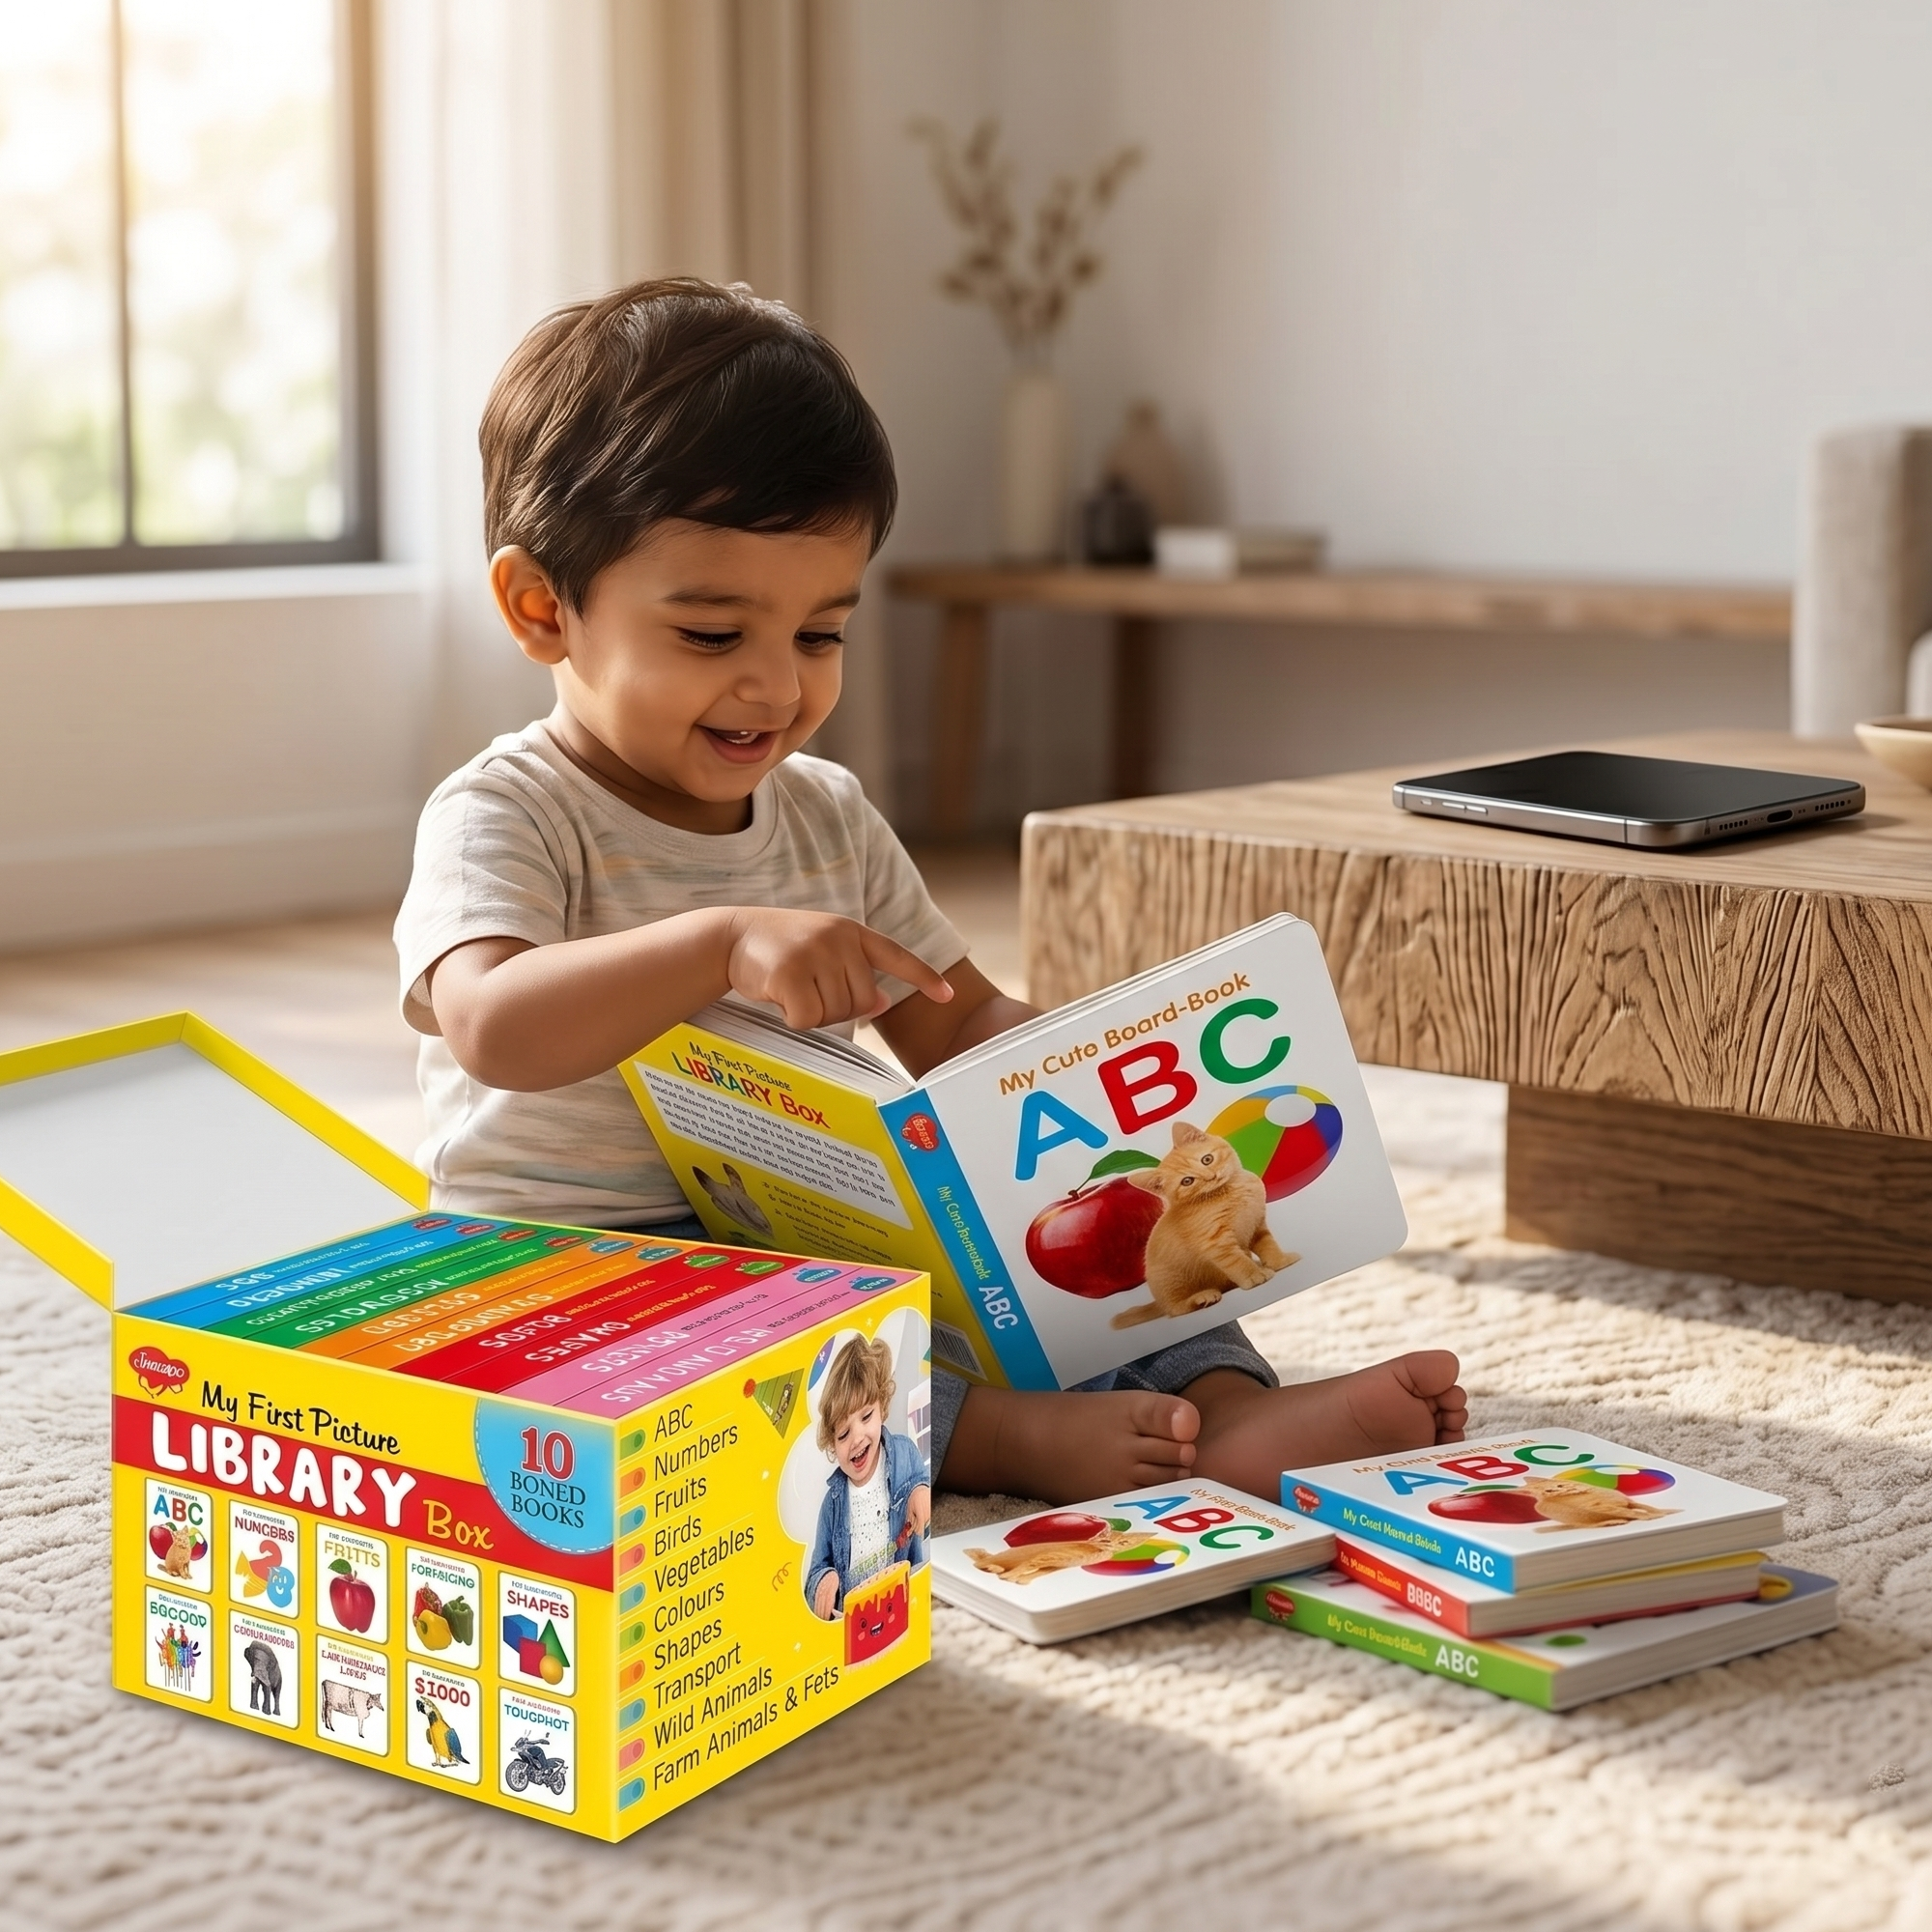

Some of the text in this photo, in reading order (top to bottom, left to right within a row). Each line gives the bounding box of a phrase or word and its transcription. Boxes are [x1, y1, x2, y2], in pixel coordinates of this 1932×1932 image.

[689, 1041, 711, 1065] My
[999, 1070, 1036, 1095] My
[1103, 971, 1251, 1050] Board-Book
[671, 1051, 773, 1106] LIBRARY
[1014, 997, 1292, 1181] ABC
[979, 1286, 1019, 1330] ABC
[201, 1380, 401, 1455] My First Picture
[654, 1404, 694, 1443] ABC
[521, 1425, 576, 1481] 10
[654, 1422, 739, 1482] Numbers
[1383, 1444, 1595, 1495] ABC
[152, 1410, 495, 1551] LIBRARY Box
[510, 1470, 585, 1505] BONED
[654, 1474, 708, 1520] Fruits
[153, 1494, 204, 1526] ABC
[511, 1493, 584, 1529] BOOKS
[654, 1514, 702, 1557] Birds
[1113, 1495, 1274, 1549] ABC
[1343, 1508, 1357, 1525] My
[654, 1522, 755, 1595] Vegetables
[1455, 1547, 1495, 1577] ABC
[506, 1589, 570, 1619] SHAPES
[654, 1579, 725, 1634] Colours
[654, 1616, 723, 1672] Shapes
[1435, 1644, 1479, 1678] ABC
[654, 1642, 742, 1711] Transport
[654, 1664, 773, 1750] Wild Animals
[654, 1748, 700, 1791] Farm
[707, 1702, 779, 1765] Animals
[784, 1687, 799, 1711] &
